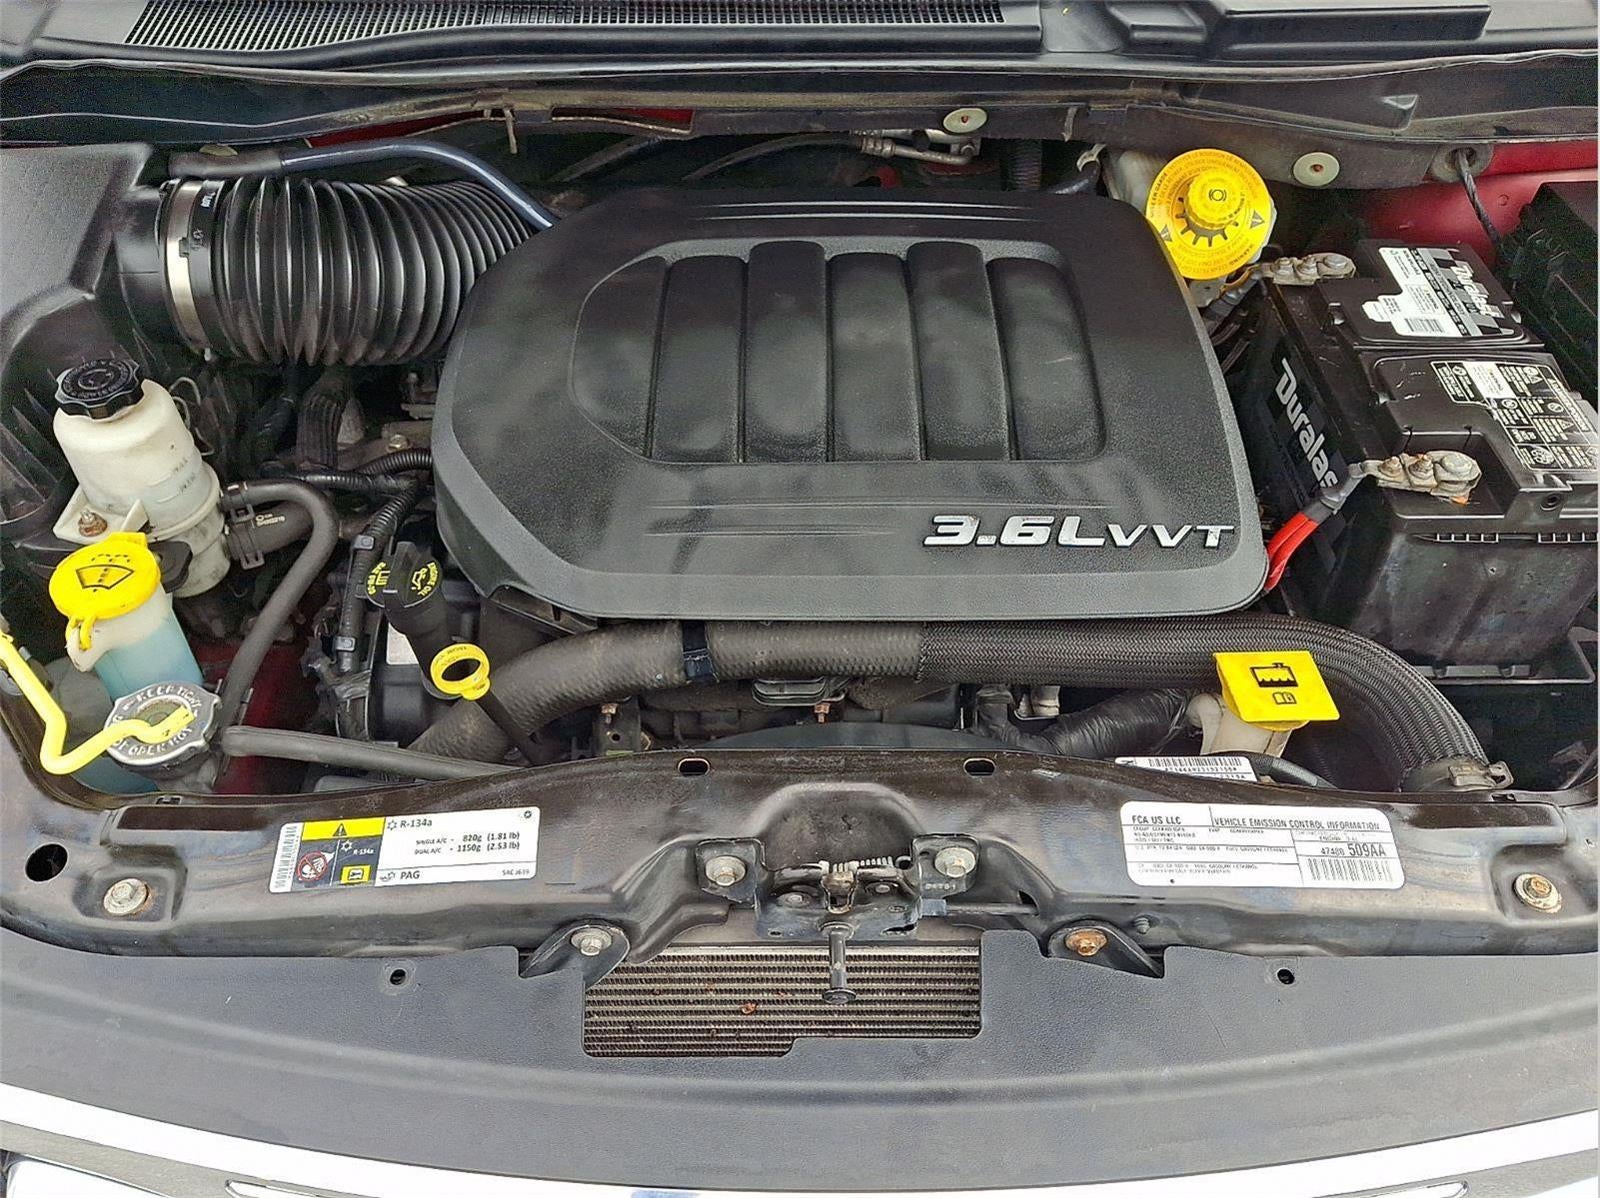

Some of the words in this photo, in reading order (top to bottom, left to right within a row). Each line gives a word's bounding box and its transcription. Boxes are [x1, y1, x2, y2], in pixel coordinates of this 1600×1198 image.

[1275, 357, 1339, 489] Duralas
[923, 515, 1106, 547] 3.6L
[1107, 523, 1235, 548] VVT
[399, 819, 433, 829] R-134a
[1131, 815, 1149, 825] FCA
[1150, 815, 1163, 825] US
[1165, 816, 1182, 825] LLC
[1213, 817, 1247, 827] VEHICLE
[1249, 818, 1287, 829] EMISSION
[1289, 820, 1325, 830] CONTROL
[1326, 821, 1380, 831] INFORMATION
[462, 834, 483, 843] 820g
[487, 832, 507, 842] (1.81
[508, 831, 520, 841] lb)
[457, 844, 481, 853] 1150g
[487, 842, 508, 852] (2.53
[508, 841, 520, 851] lb)
[1347, 843, 1387, 857] 509AA
[400, 871, 421, 881] PAG
